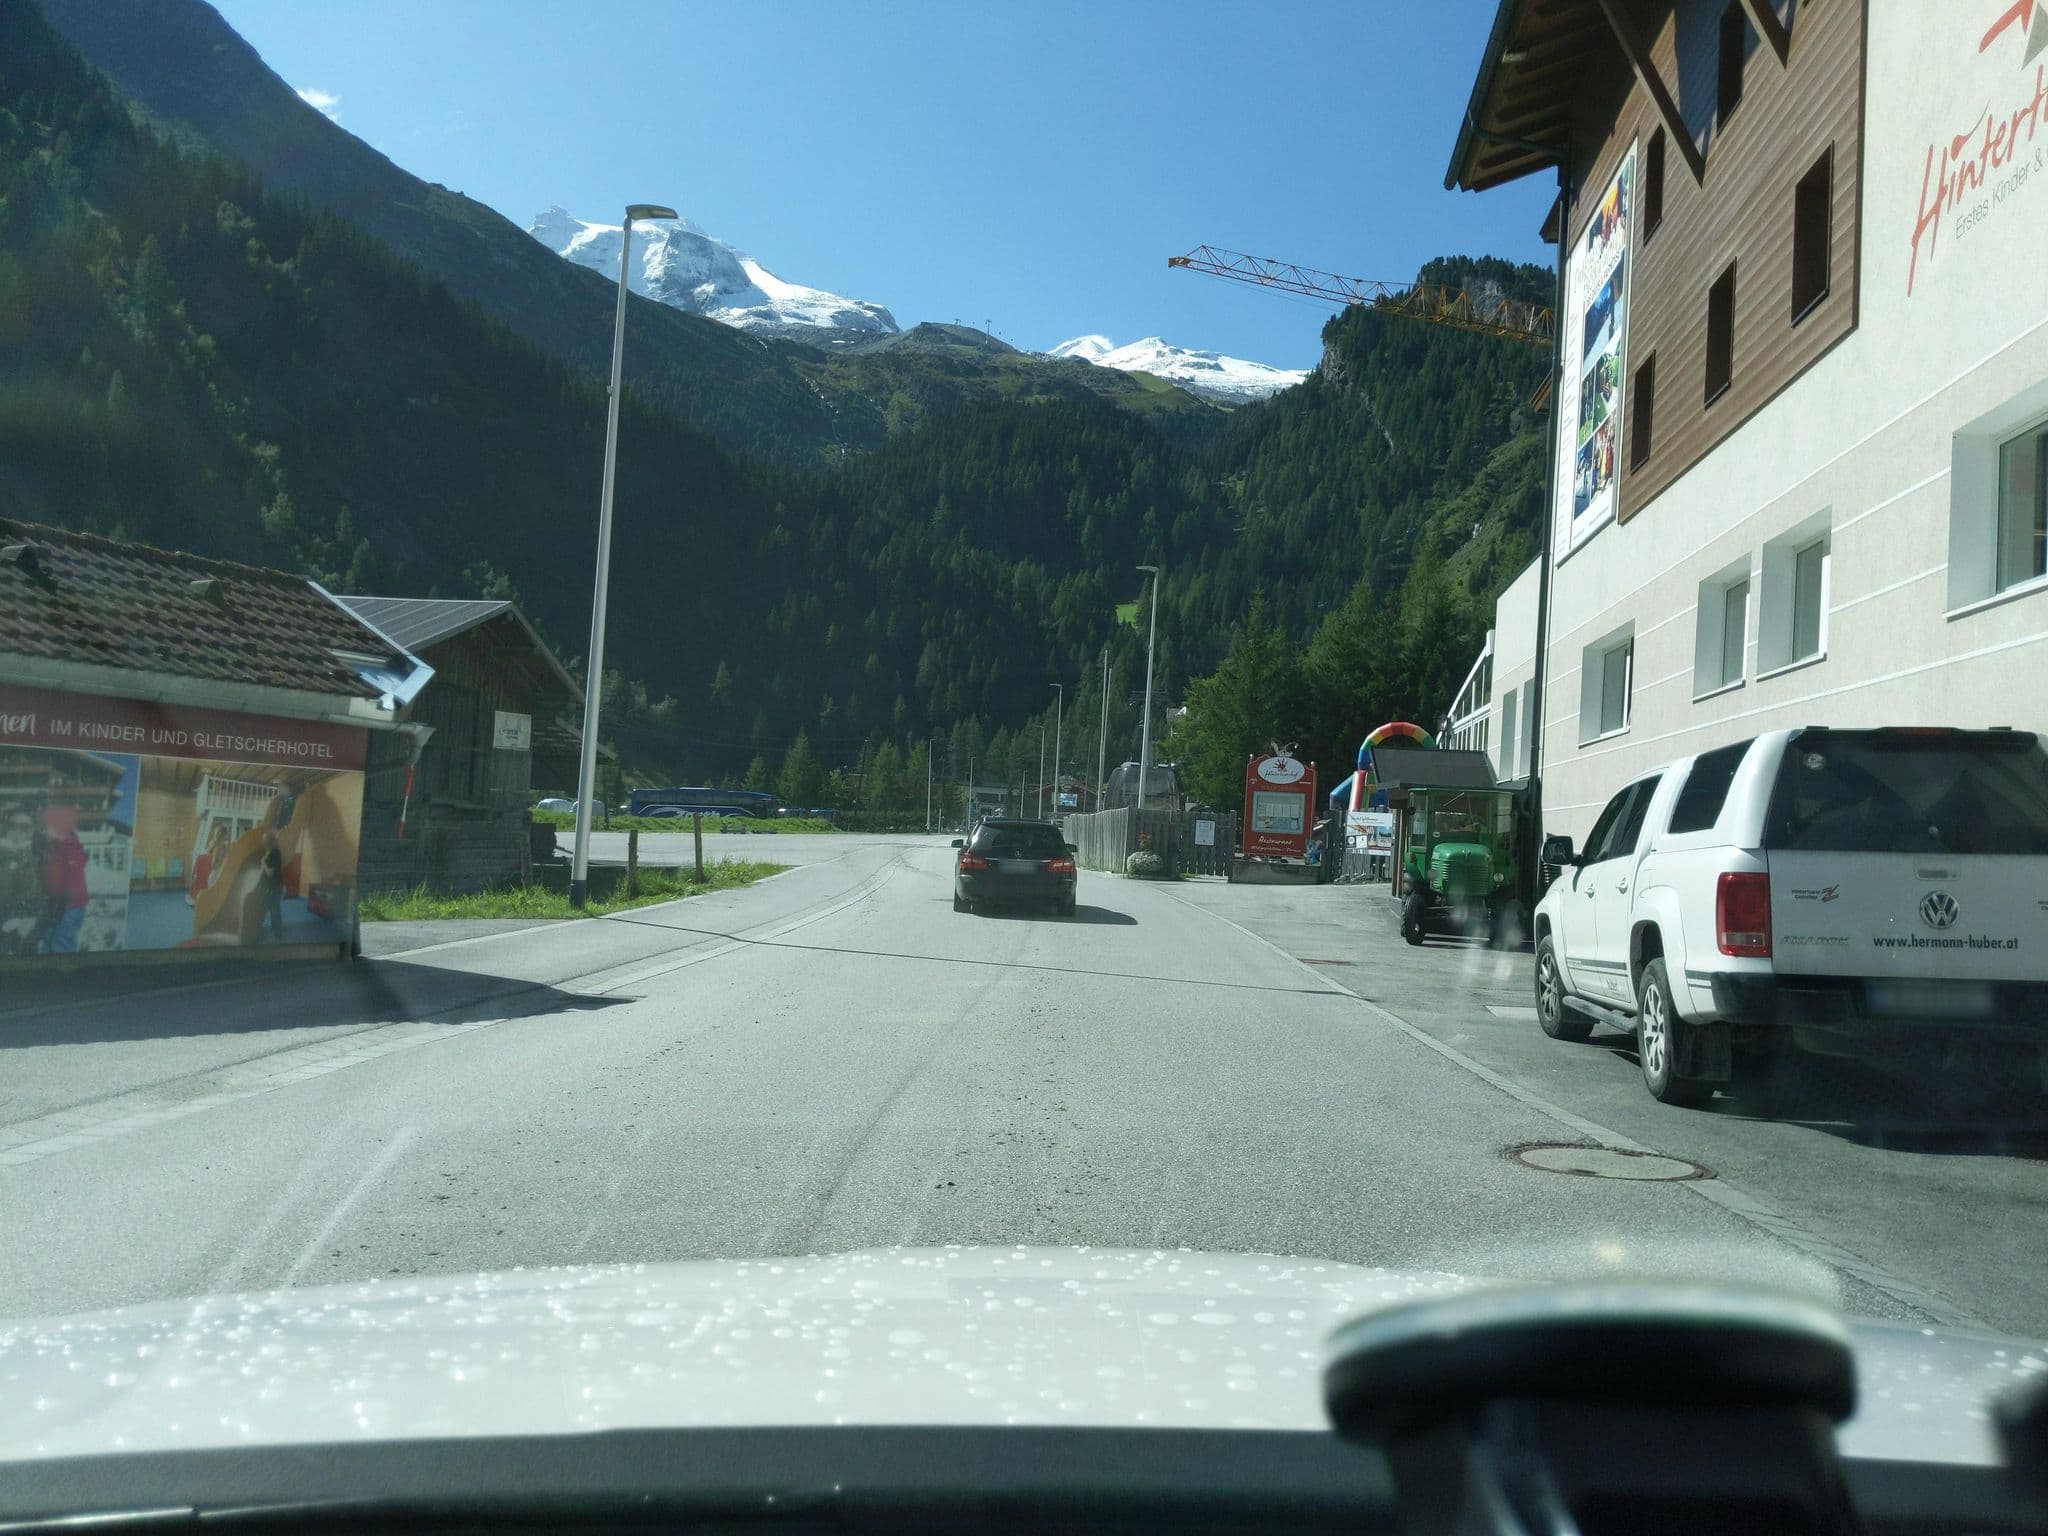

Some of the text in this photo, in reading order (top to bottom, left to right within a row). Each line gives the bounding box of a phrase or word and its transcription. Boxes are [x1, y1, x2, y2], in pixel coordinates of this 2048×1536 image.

[1955, 200, 1990, 240] Erstes
[1992, 162, 2030, 208] Kinder
[2033, 147, 2044, 173] &
[50, 719, 72, 736] IM
[79, 722, 146, 742] KINDER
[152, 729, 188, 746] UND
[193, 734, 335, 758] GLETSCHERHOTEL
[1873, 934, 2019, 949] www.hermann-huber.at
